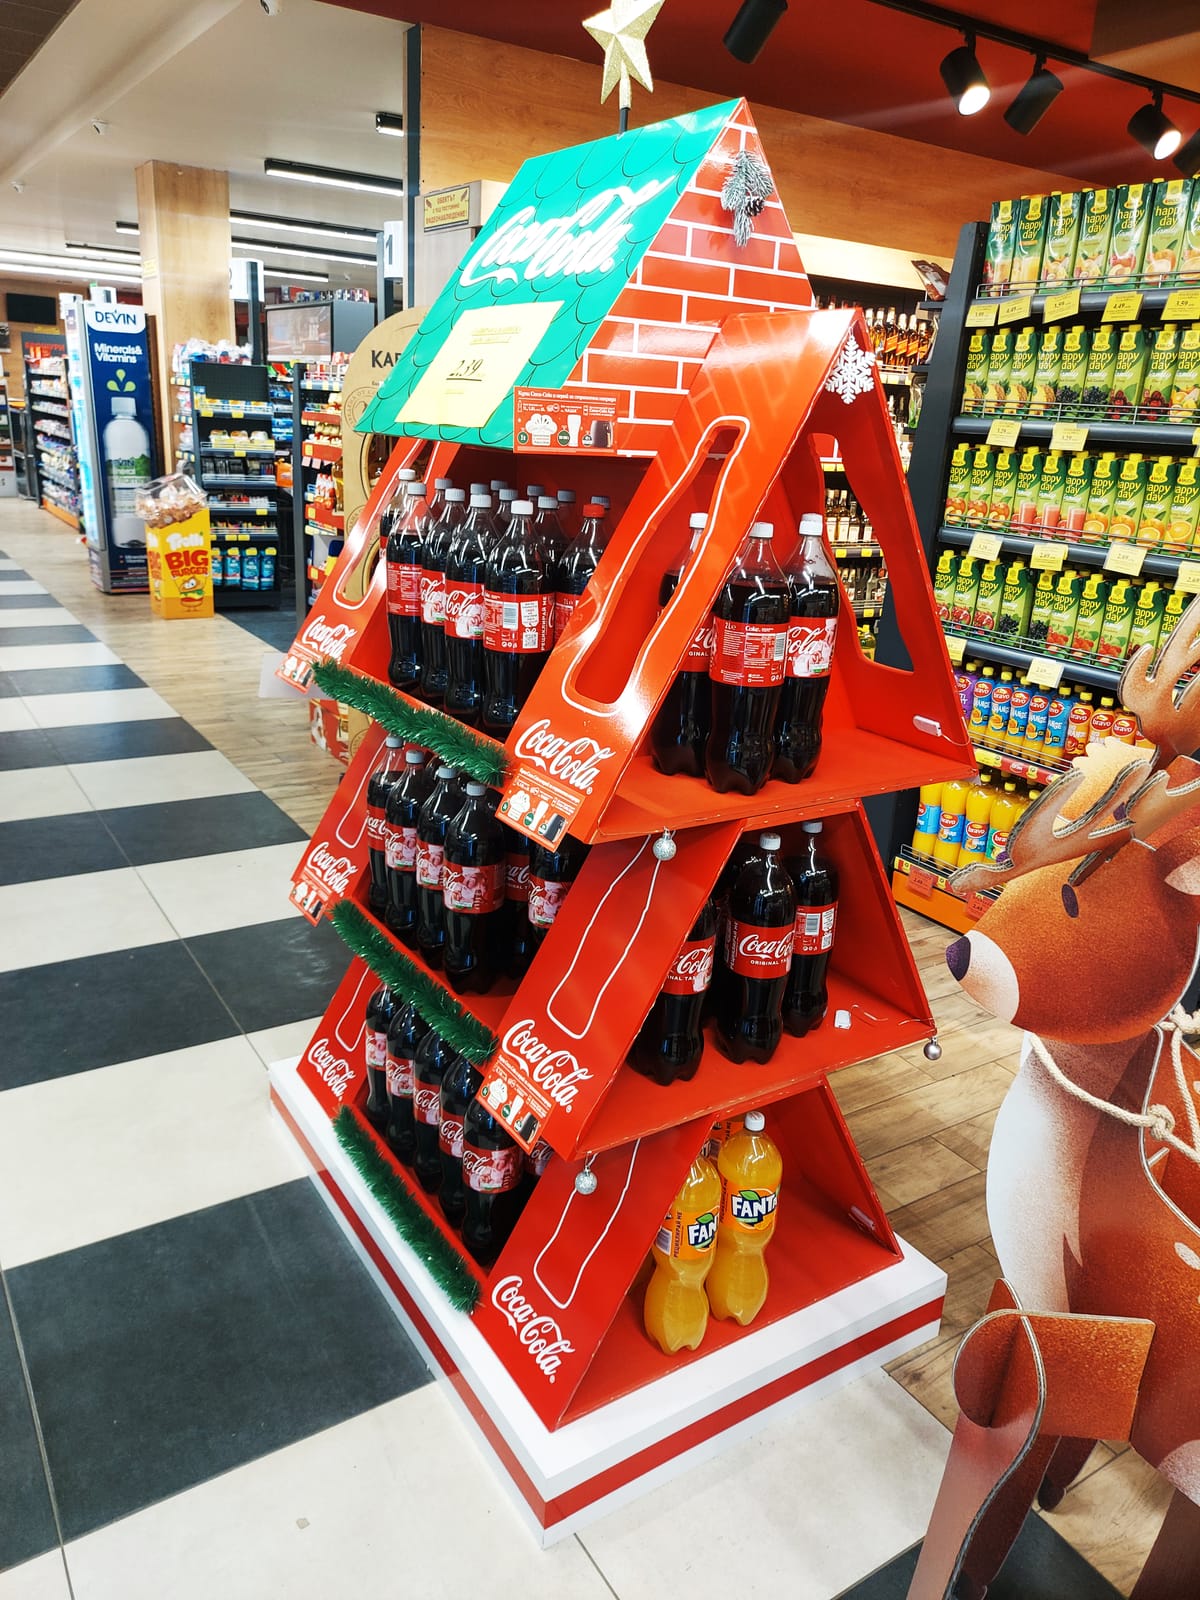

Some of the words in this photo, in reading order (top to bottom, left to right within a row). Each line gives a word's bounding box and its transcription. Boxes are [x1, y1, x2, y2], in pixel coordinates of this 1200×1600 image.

[1052, 217, 1075, 229] happy
[1086, 213, 1109, 224] happy
[459, 175, 676, 287] Coca-Cola
[1019, 220, 1043, 232] happy
[1088, 223, 1103, 234] day
[1022, 230, 1038, 241] day
[1054, 226, 1070, 237] day
[95, 310, 137, 325] DEVIN
[95, 352, 137, 364] Vitamins
[968, 353, 986, 363] appy
[990, 353, 1010, 363] appy
[1013, 353, 1032, 363] appy
[1062, 353, 1084, 363] appy
[1090, 352, 1113, 362] appy
[1117, 352, 1139, 362] appy
[1179, 350, 1200, 362] appy
[967, 361, 980, 370] day
[990, 361, 1003, 370] day
[1012, 361, 1026, 370] day
[1061, 361, 1077, 370] day
[1089, 361, 1106, 370] day
[1116, 361, 1132, 370] day
[1151, 360, 1170, 370] day
[1178, 360, 1197, 371] day
[950, 467, 969, 476] appy
[972, 469, 991, 478] appy
[994, 471, 1013, 480] appy
[949, 474, 963, 483] day
[971, 477, 985, 486] day
[1018, 472, 1037, 482] appy
[1041, 475, 1061, 485] appy
[1065, 477, 1087, 487] appy
[993, 479, 1007, 488] day
[1017, 481, 1031, 490] day
[1040, 483, 1055, 492] day
[1092, 479, 1113, 489] appy
[1117, 480, 1141, 491] appy
[1147, 483, 1171, 493] appy
[1065, 486, 1080, 496] day
[1091, 487, 1107, 497] day
[1117, 489, 1134, 500] day
[1175, 486, 1199, 496] appy
[1146, 493, 1163, 503] day
[1174, 495, 1191, 506] day
[165, 550, 209, 570] BIG
[170, 567, 209, 578] BURGER
[935, 573, 953, 583] appy
[957, 577, 975, 587] appy
[935, 581, 948, 590] day
[956, 584, 969, 593] day
[980, 581, 998, 591] appy
[1004, 585, 1023, 594] appy
[980, 589, 993, 598] day
[1004, 593, 1017, 601] day
[1035, 590, 1055, 600] appy
[446, 590, 484, 616] Cola
[1034, 599, 1050, 608] day
[1054, 594, 1075, 605] appy
[1080, 599, 1101, 609] appy
[1053, 602, 1068, 612] day
[1079, 606, 1094, 617] day
[1106, 604, 1129, 614] appy
[1105, 612, 1122, 622] day
[1135, 608, 1157, 618] appy
[1134, 617, 1150, 628] day
[1164, 614, 1180, 624] app
[1162, 623, 1175, 632] da
[302, 615, 358, 664] Coca-Cola
[1092, 717, 1112, 727] bravo
[1114, 723, 1133, 733] bravo
[514, 718, 617, 796] Coca-Cola
[967, 826, 985, 835] bravo
[307, 841, 359, 897] Coca-Cola
[307, 1038, 357, 1102] Coca-Cola
[501, 1019, 594, 1114] Coca-Cola
[688, 1214, 718, 1245] FAN
[491, 1275, 576, 1384] Coca-Cola
